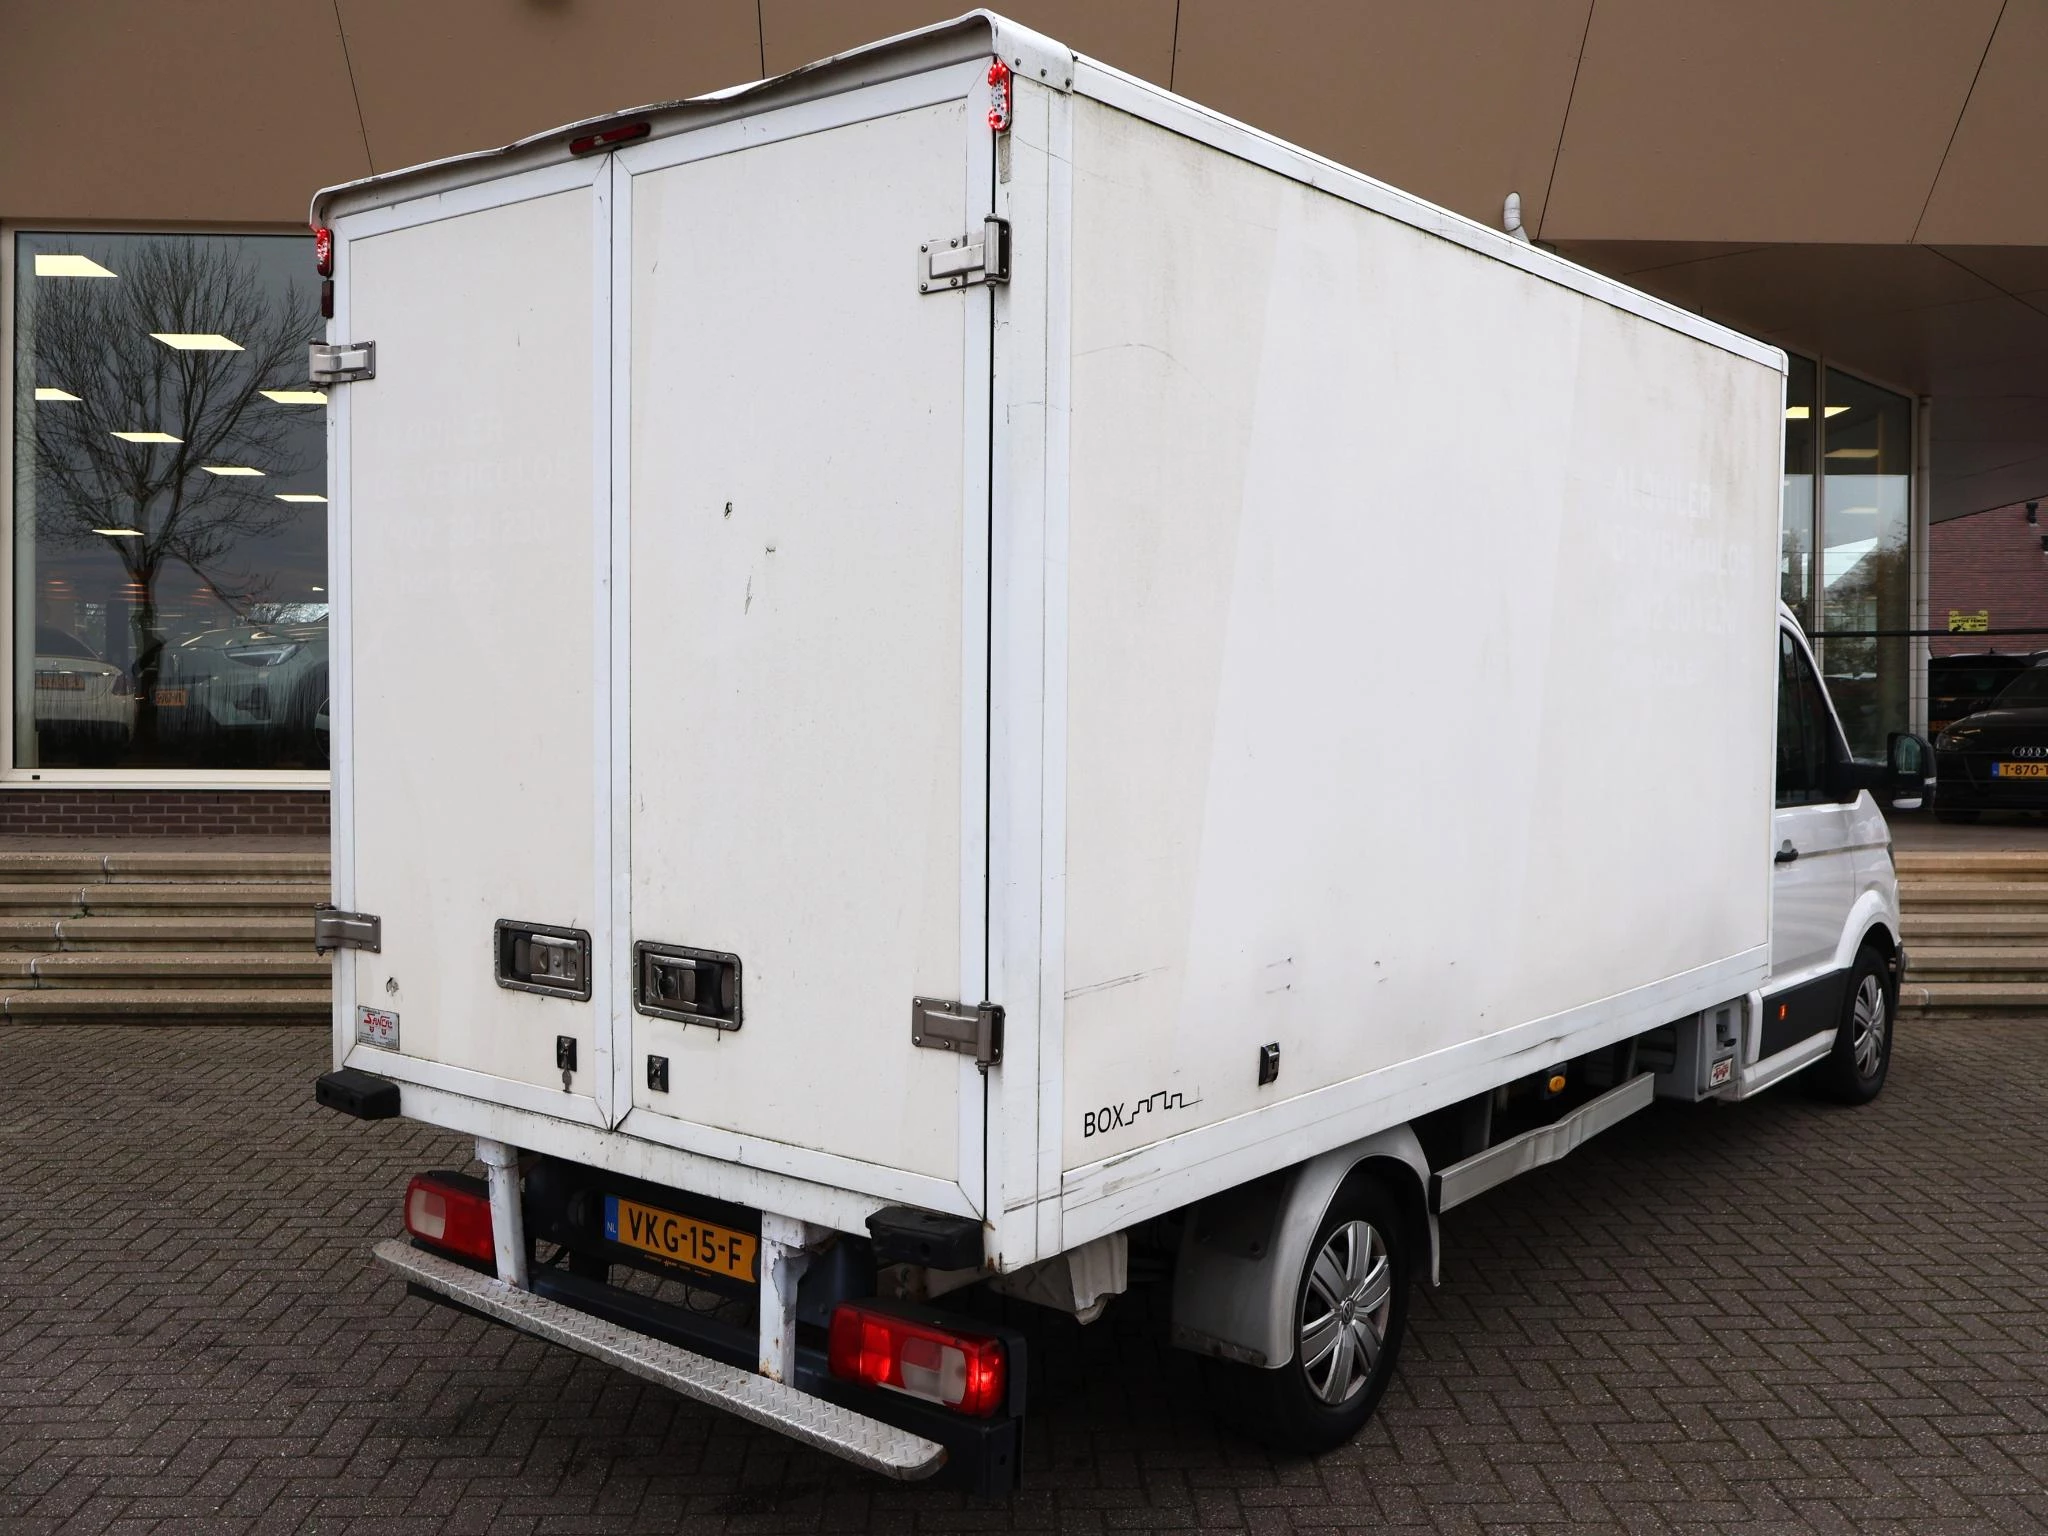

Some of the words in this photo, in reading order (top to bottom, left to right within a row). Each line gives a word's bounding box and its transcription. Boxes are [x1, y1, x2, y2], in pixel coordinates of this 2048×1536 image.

[1084, 1102, 1124, 1138] BOX
[607, 1221, 616, 1233] NL
[628, 1207, 742, 1270] VKG-15-F
